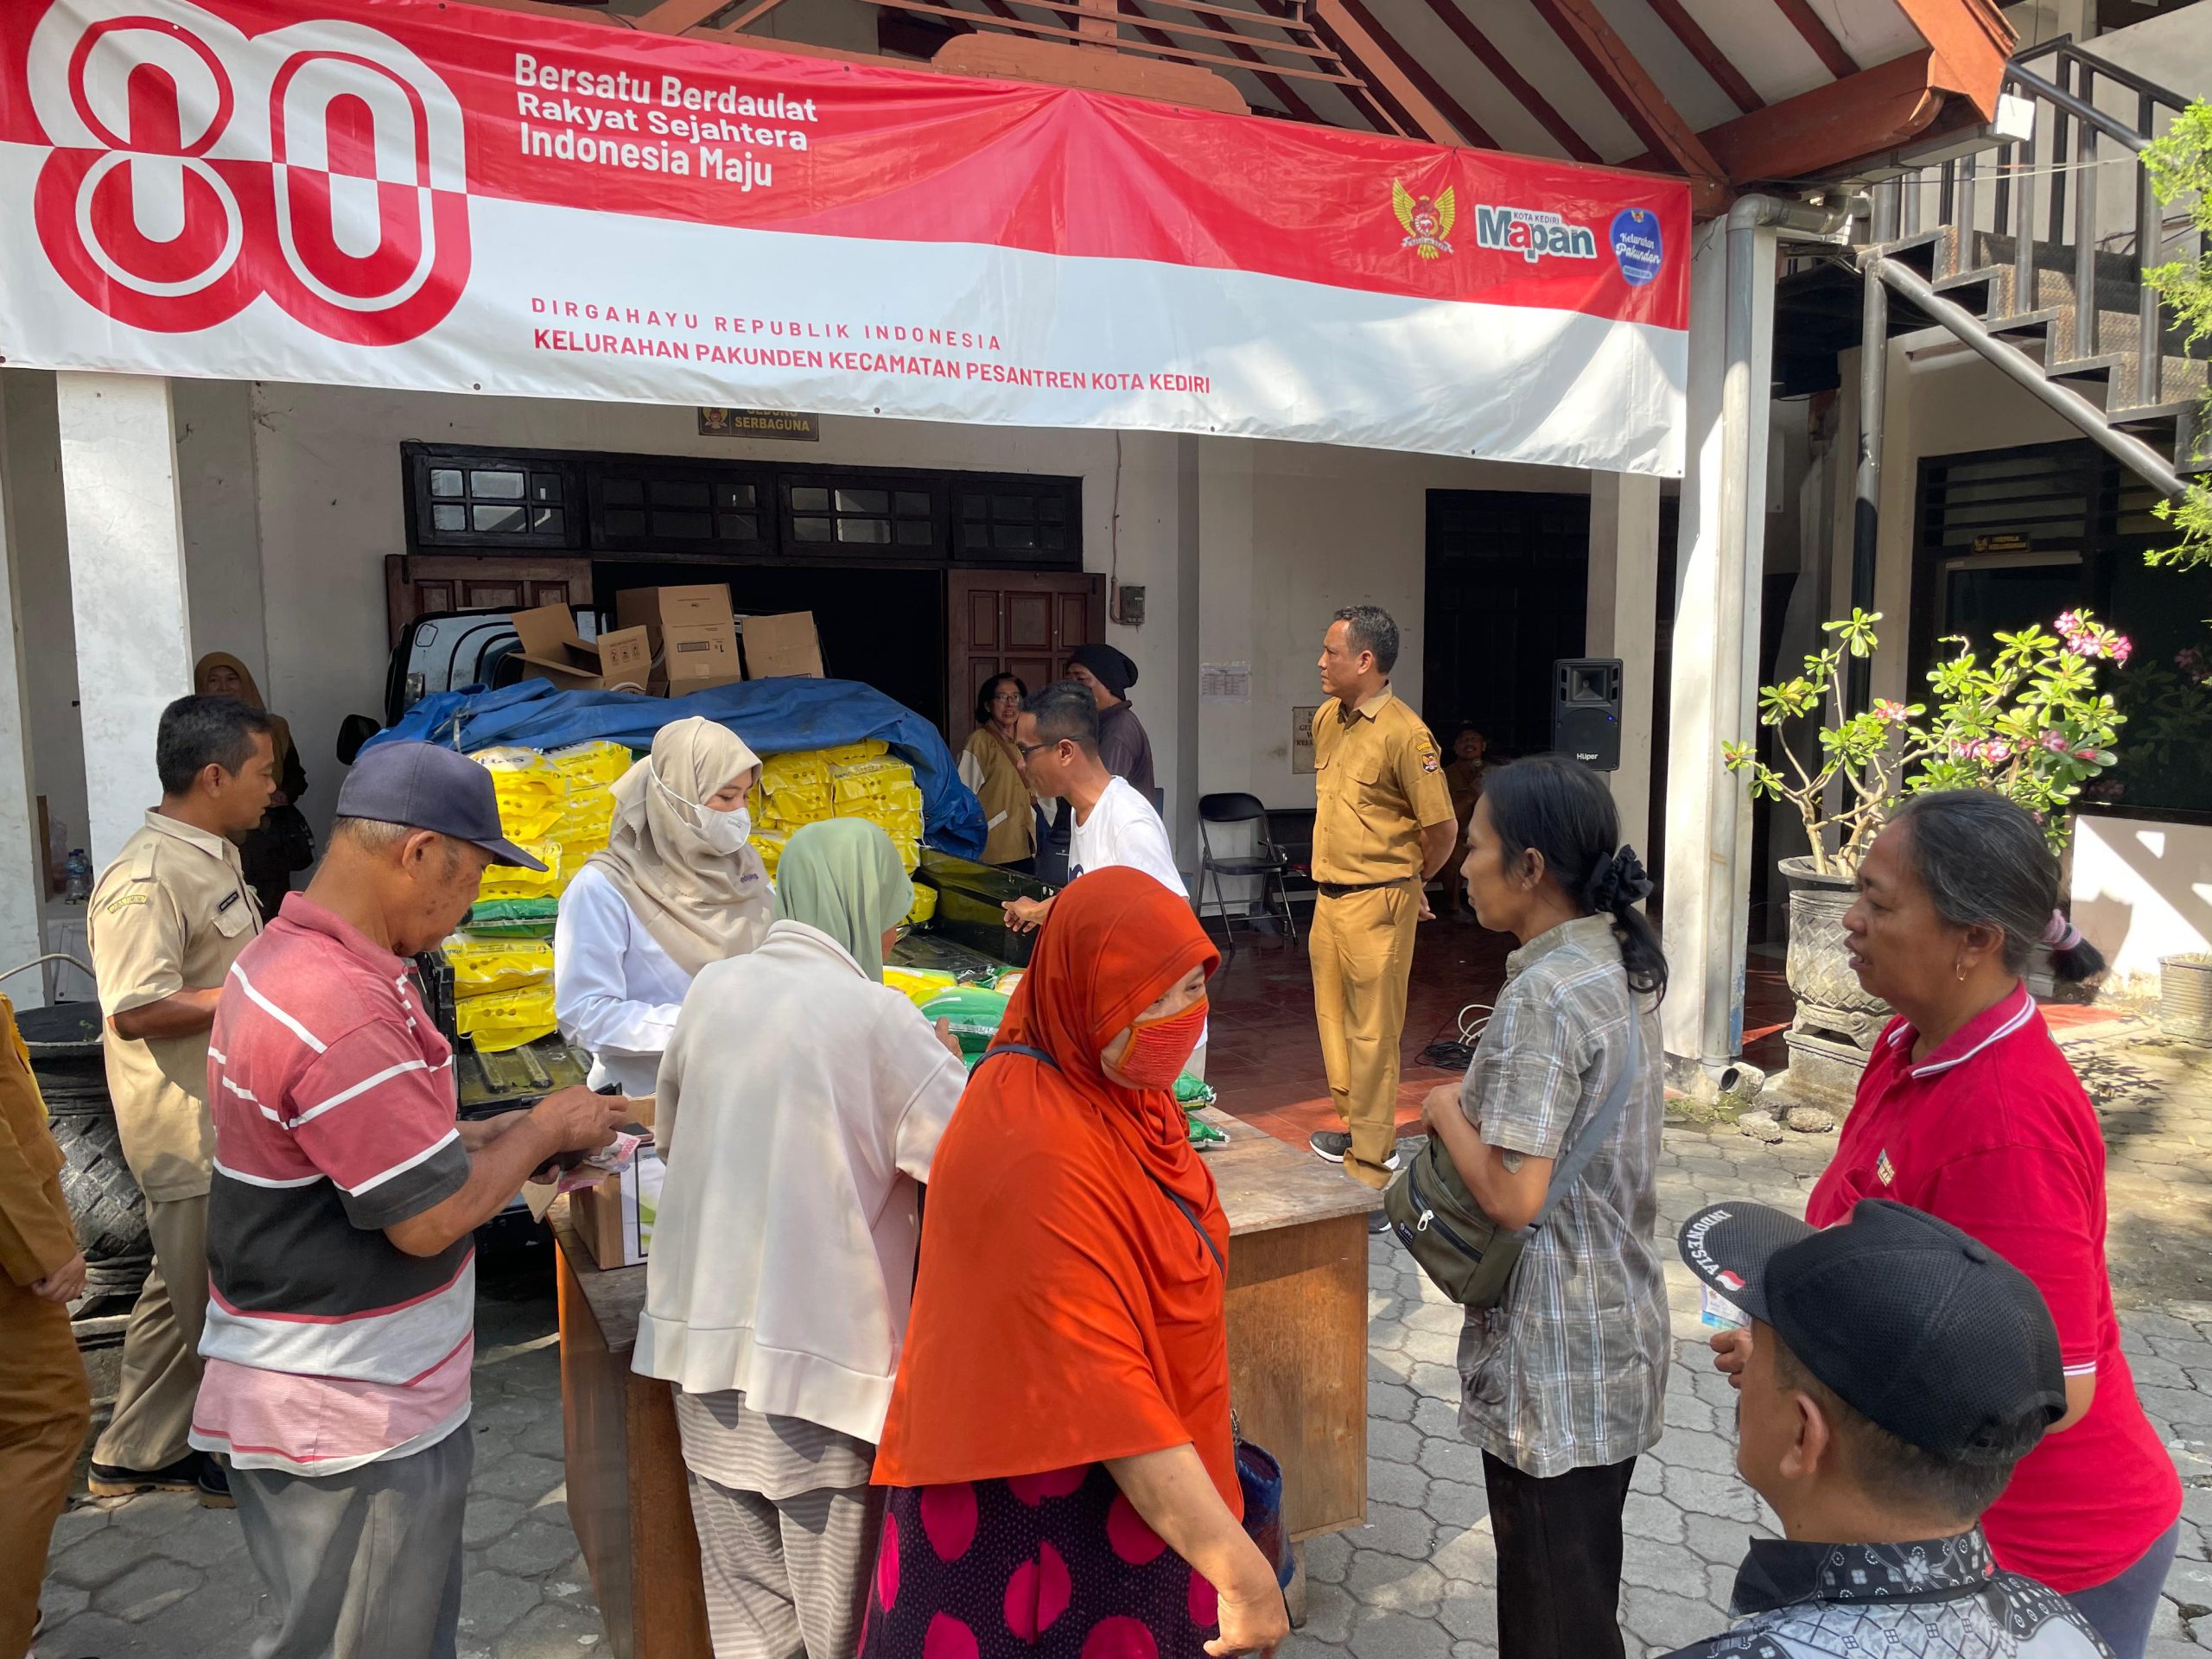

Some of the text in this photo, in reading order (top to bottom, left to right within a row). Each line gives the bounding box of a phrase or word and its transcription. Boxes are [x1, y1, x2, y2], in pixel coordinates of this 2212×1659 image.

[515, 53, 818, 122] Bersatu Berdaulat
[518, 92, 808, 151] Rakyat Sejahtera
[26, 0, 473, 347] 80
[520, 122, 772, 192] Indonesia Maju
[1478, 207, 1594, 259] Mapan
[1514, 212, 1560, 225] KOTA KEDIRI
[1619, 232, 1655, 250] Kelurahan
[1615, 243, 1661, 264] Pakunden
[531, 297, 1001, 351] DIRGAHAYU REPUBLIK INDONESIA
[534, 328, 1211, 394] KELURAHAN PAKUNDEN KECAMATAN PESANTREN KOTA KEDIRI
[734, 416, 810, 432] SERBAGUNA
[1686, 1210, 1733, 1275] INDONESIA
